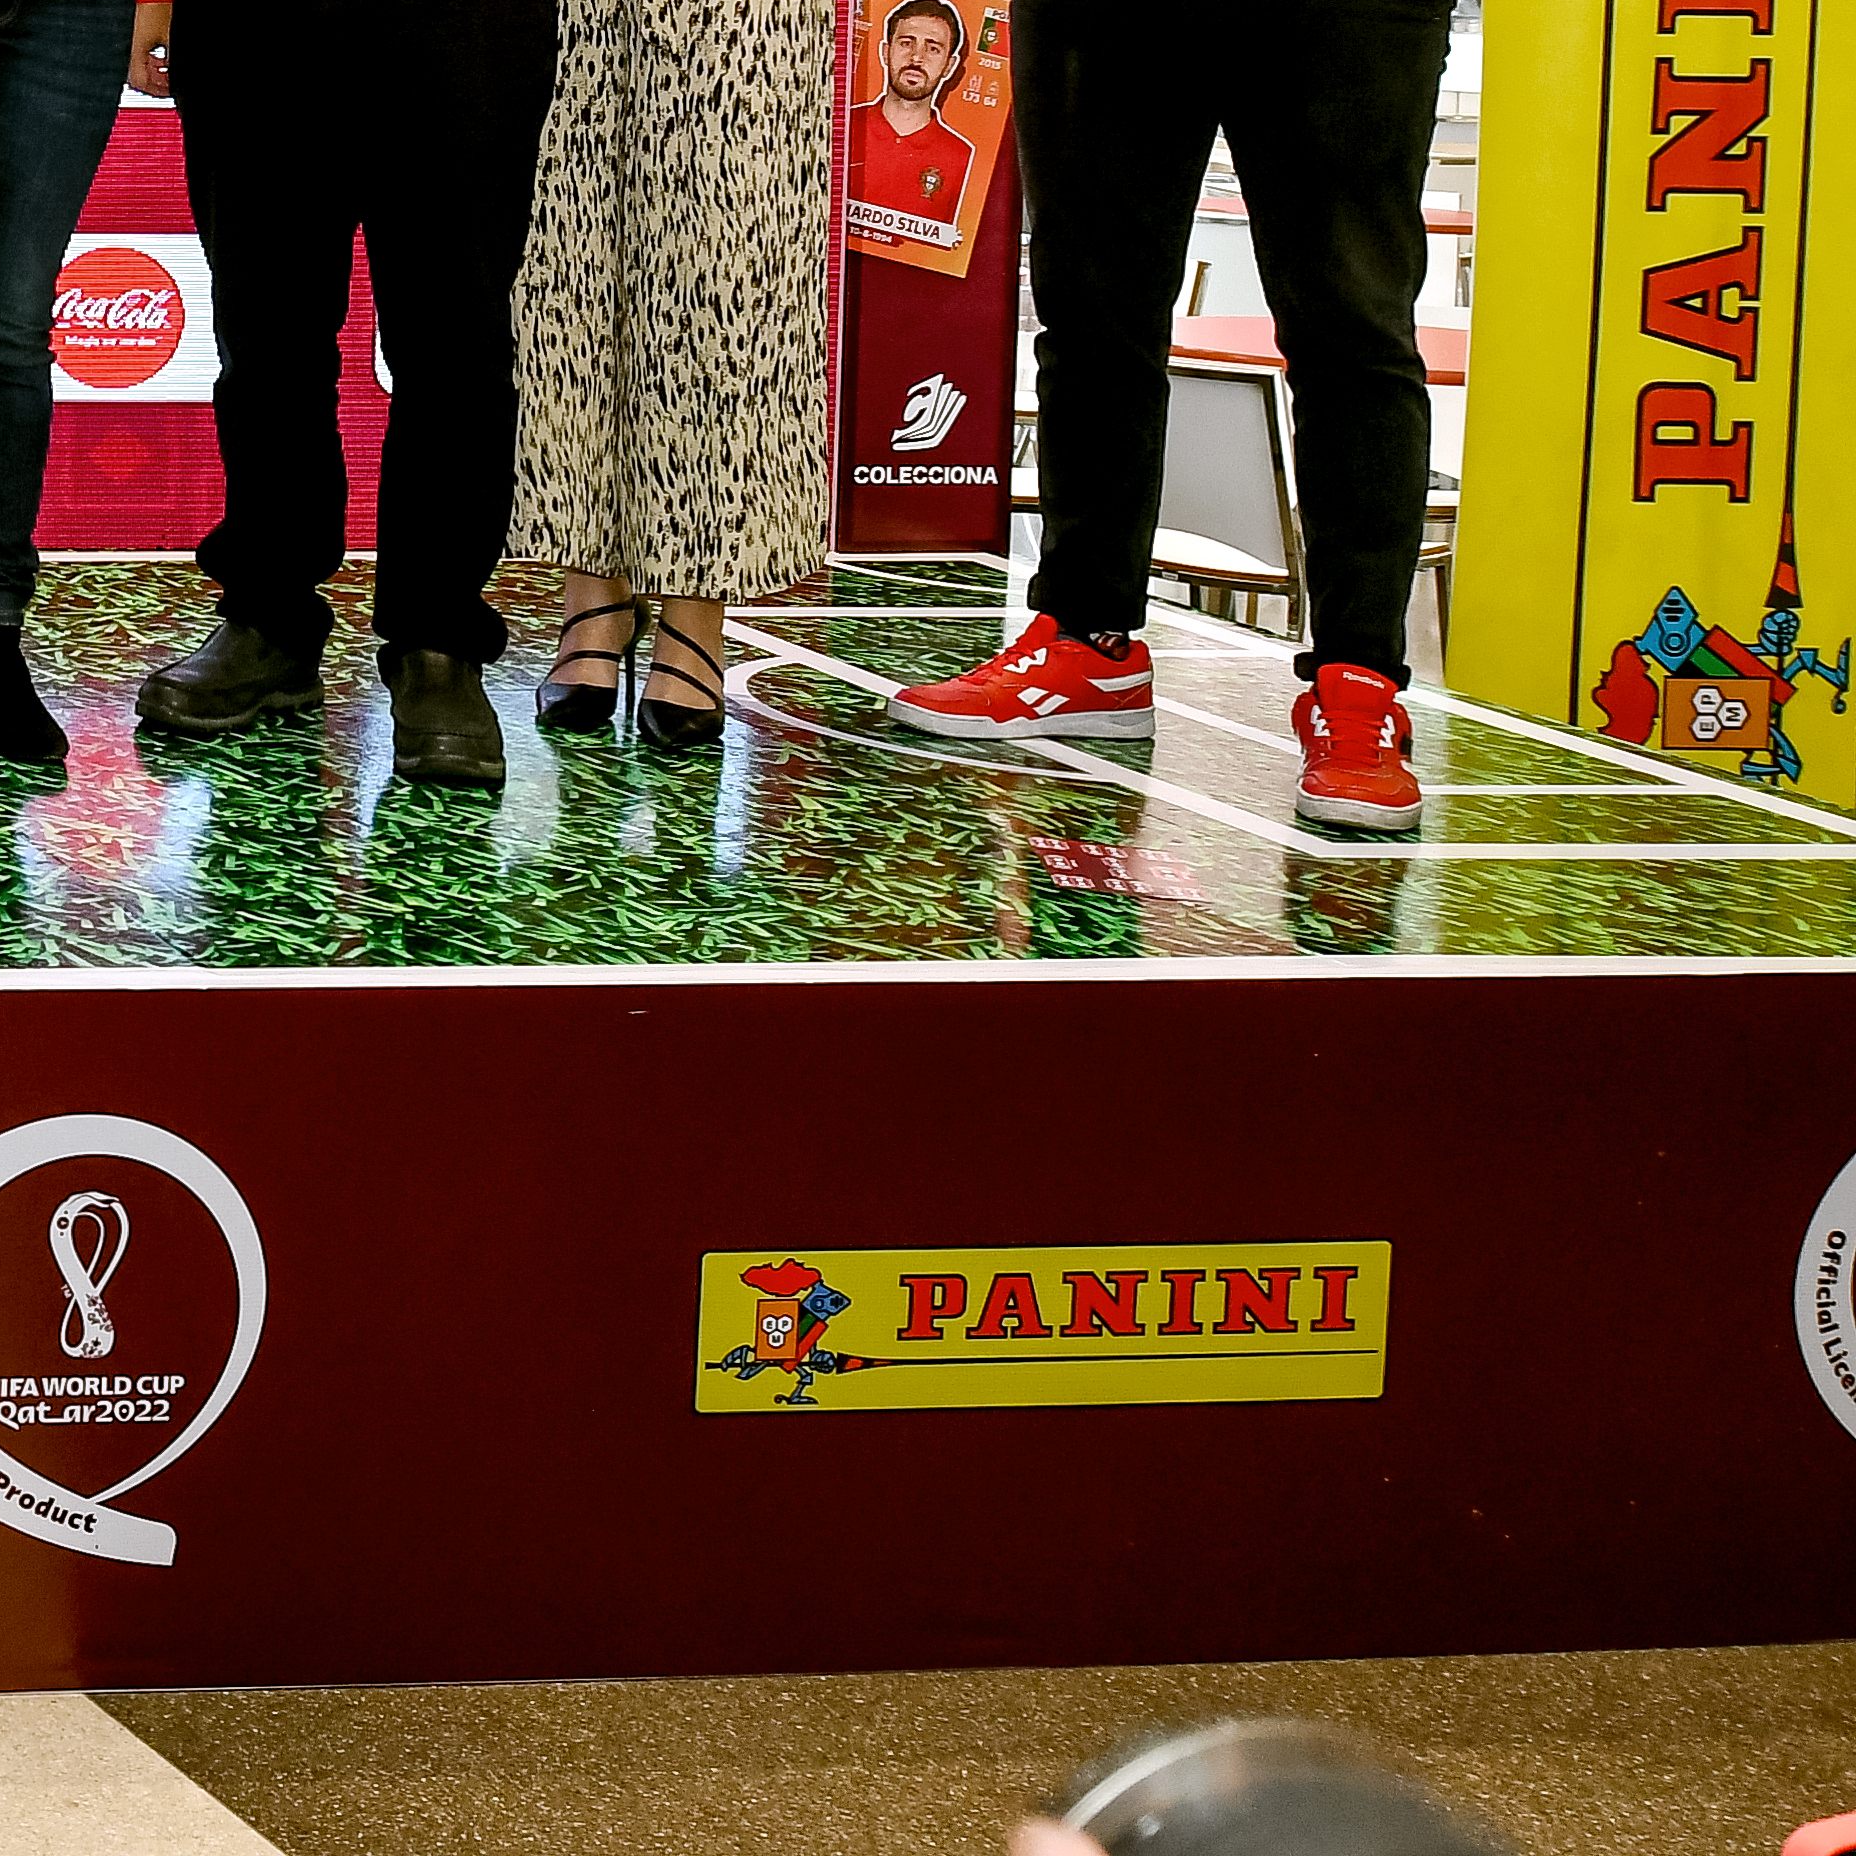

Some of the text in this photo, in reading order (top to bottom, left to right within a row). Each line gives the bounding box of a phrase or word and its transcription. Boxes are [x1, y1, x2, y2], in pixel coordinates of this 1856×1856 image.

[847, 202, 941, 240] ARDO SILVA
[852, 465, 1000, 485] COLECCIONA
[896, 1265, 1360, 1342] PANINI
[1815, 1229, 1856, 1404] Official Lice
[41, 1375, 134, 1397] WORLD
[135, 1374, 186, 1395] CUP
